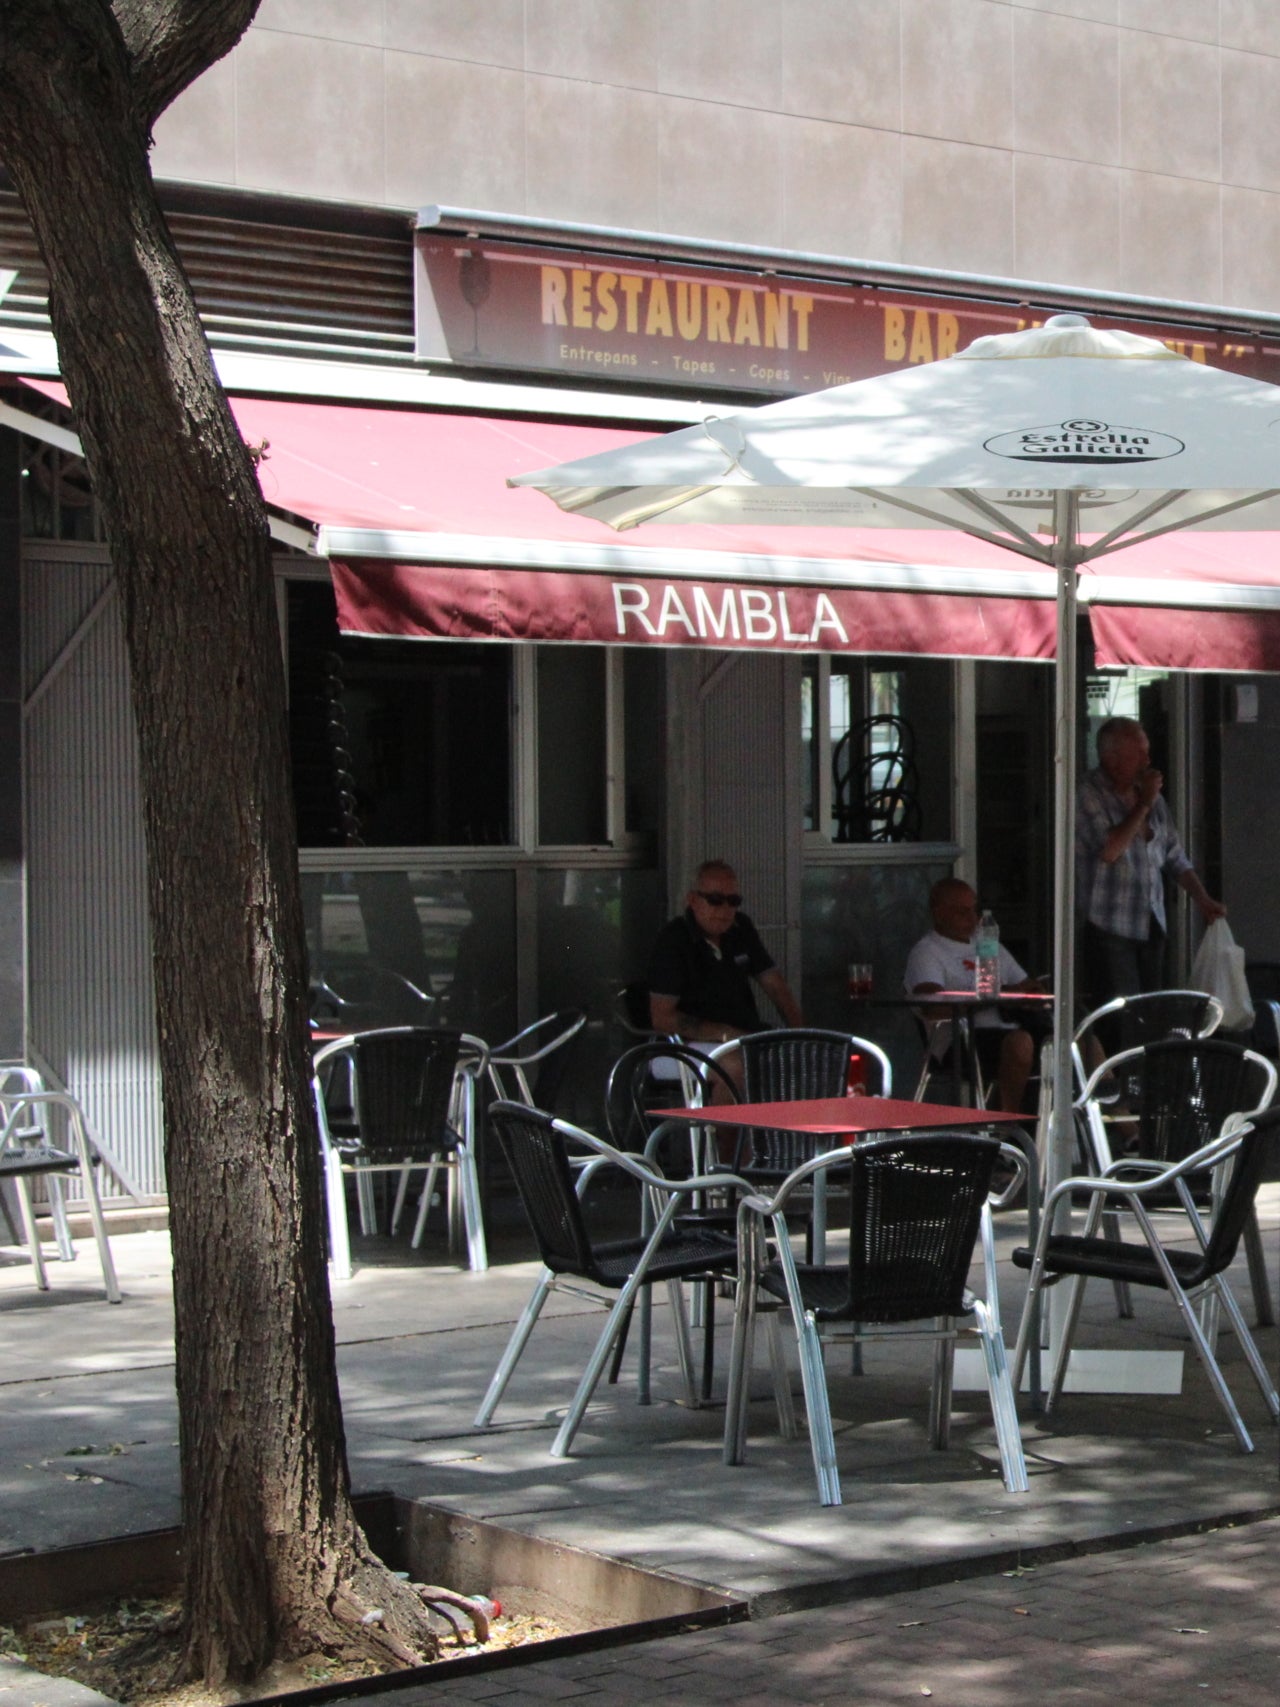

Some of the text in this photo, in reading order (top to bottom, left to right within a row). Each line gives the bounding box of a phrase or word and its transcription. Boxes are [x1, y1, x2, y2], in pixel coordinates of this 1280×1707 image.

[541, 266, 959, 363] RESTAURANT BAR
[560, 344, 637, 366] Entrepans
[673, 355, 715, 374] Tapes
[749, 364, 790, 382] Copes
[823, 371, 851, 385] Vins
[1019, 432, 1150, 445] Estrella
[1022, 443, 1146, 455] Galicia
[612, 582, 849, 643] RAMBLA
